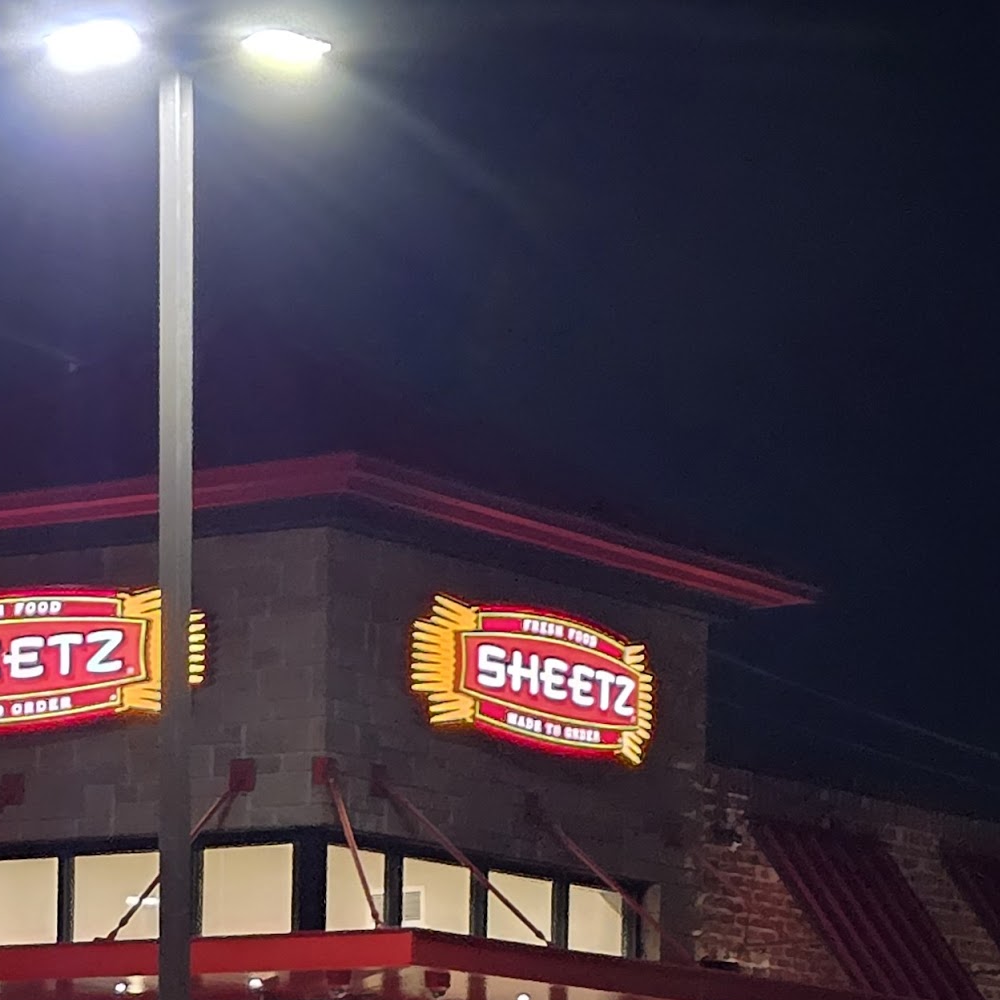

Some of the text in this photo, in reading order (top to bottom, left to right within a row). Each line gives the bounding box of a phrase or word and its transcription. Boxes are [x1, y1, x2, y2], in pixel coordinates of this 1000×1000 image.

[14, 601, 61, 616] FOOD
[522, 619, 598, 649] FRESH FOOD
[477, 644, 636, 717] SHEETZ
[11, 696, 72, 715] ORDER
[506, 712, 600, 743] MADE TO ORDER
